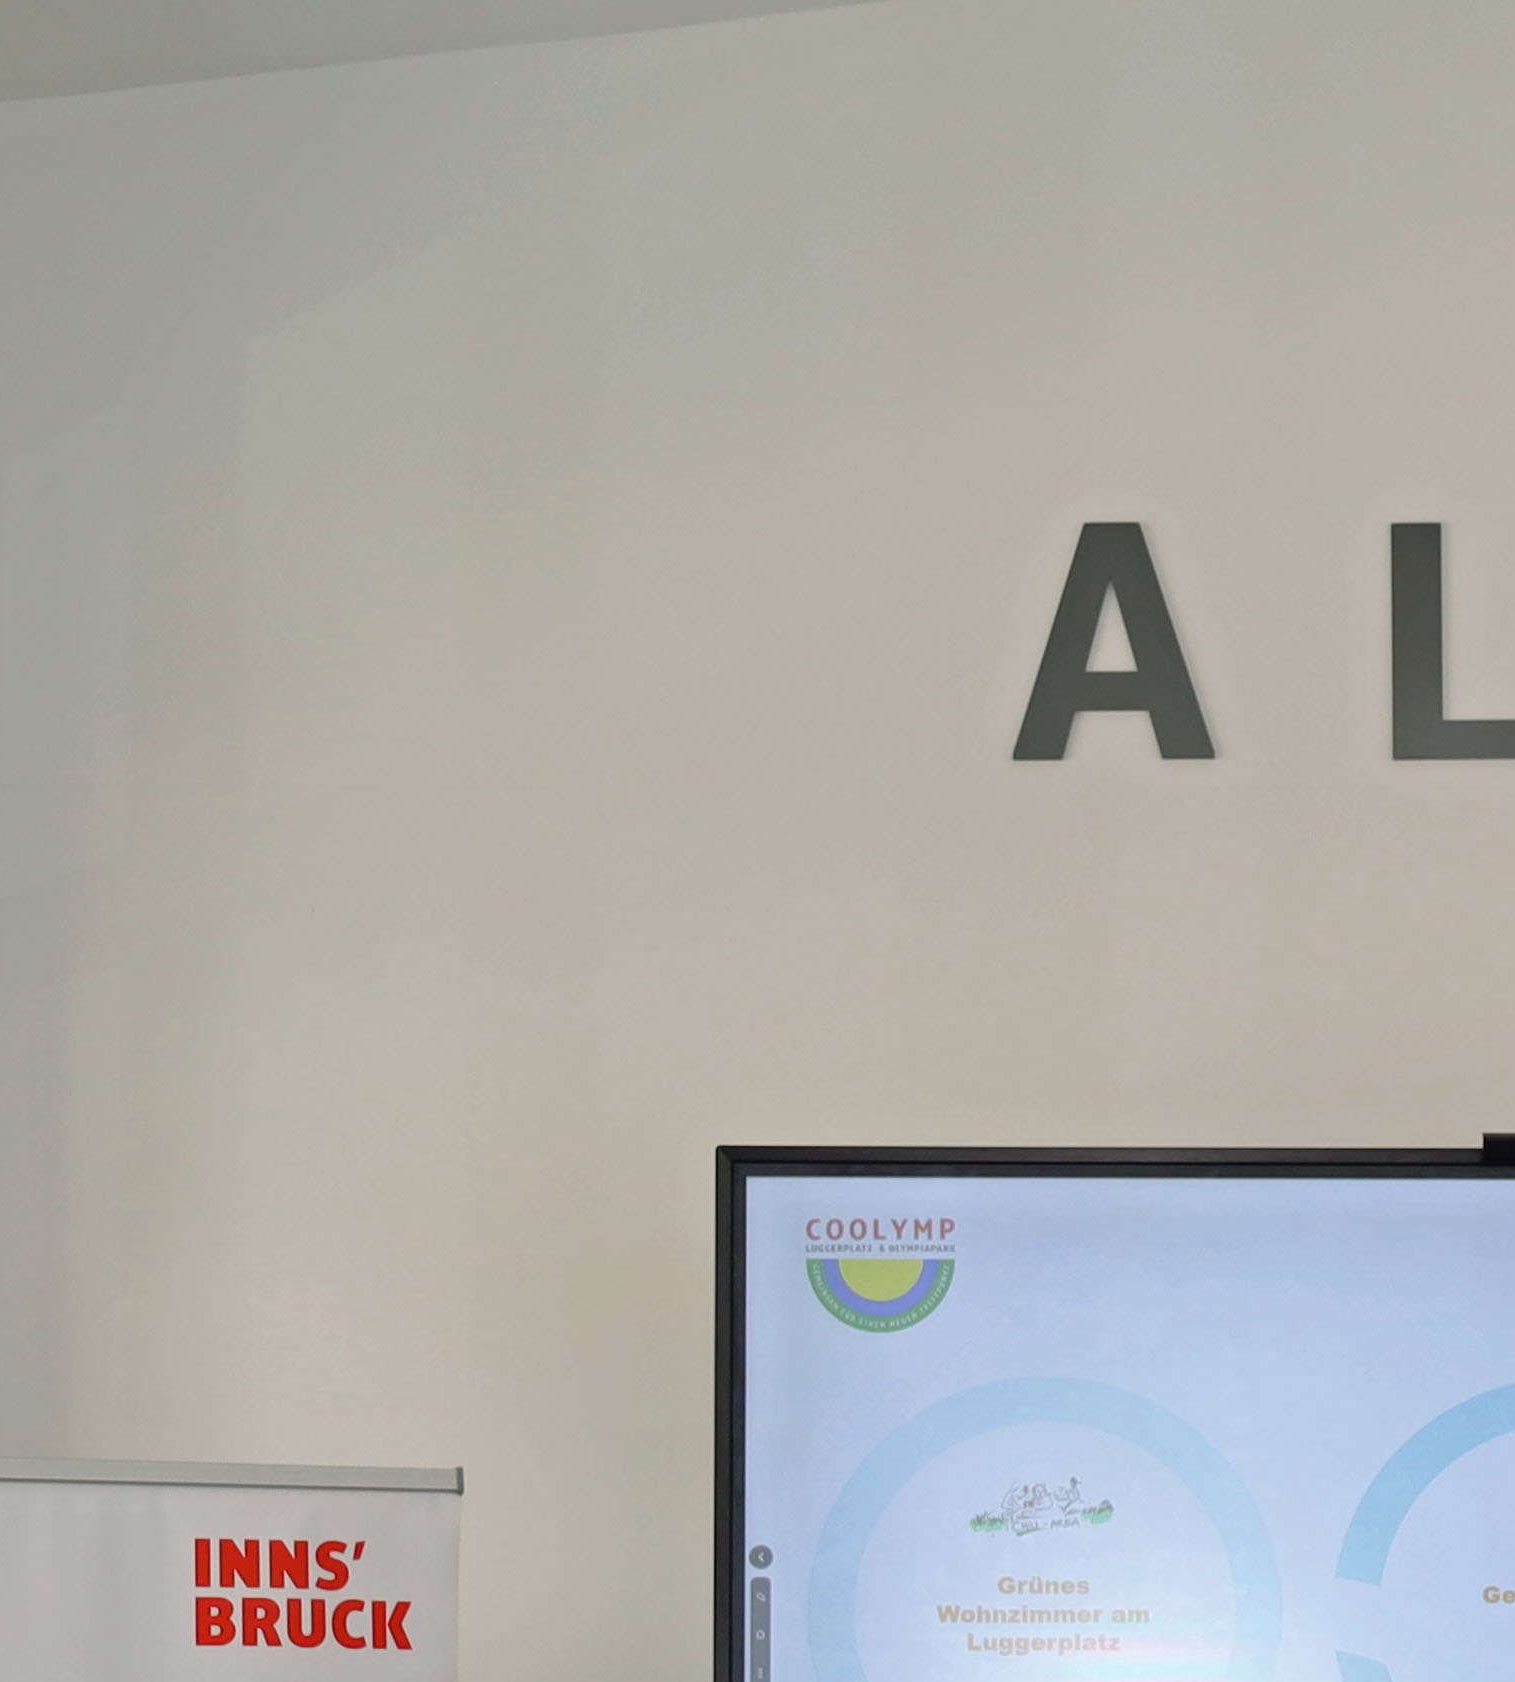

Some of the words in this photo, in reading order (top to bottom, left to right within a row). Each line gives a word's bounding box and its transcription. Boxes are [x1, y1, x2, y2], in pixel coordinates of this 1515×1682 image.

[805, 1218, 957, 1241] COOLYMP
[996, 1576, 1091, 1595] Grünes
[195, 1597, 413, 1650] BRUCK
[936, 1605, 1103, 1624] Wohnzimmer
[1110, 1609, 1151, 1624] am
[966, 1632, 1122, 1656] Luggerplatz
